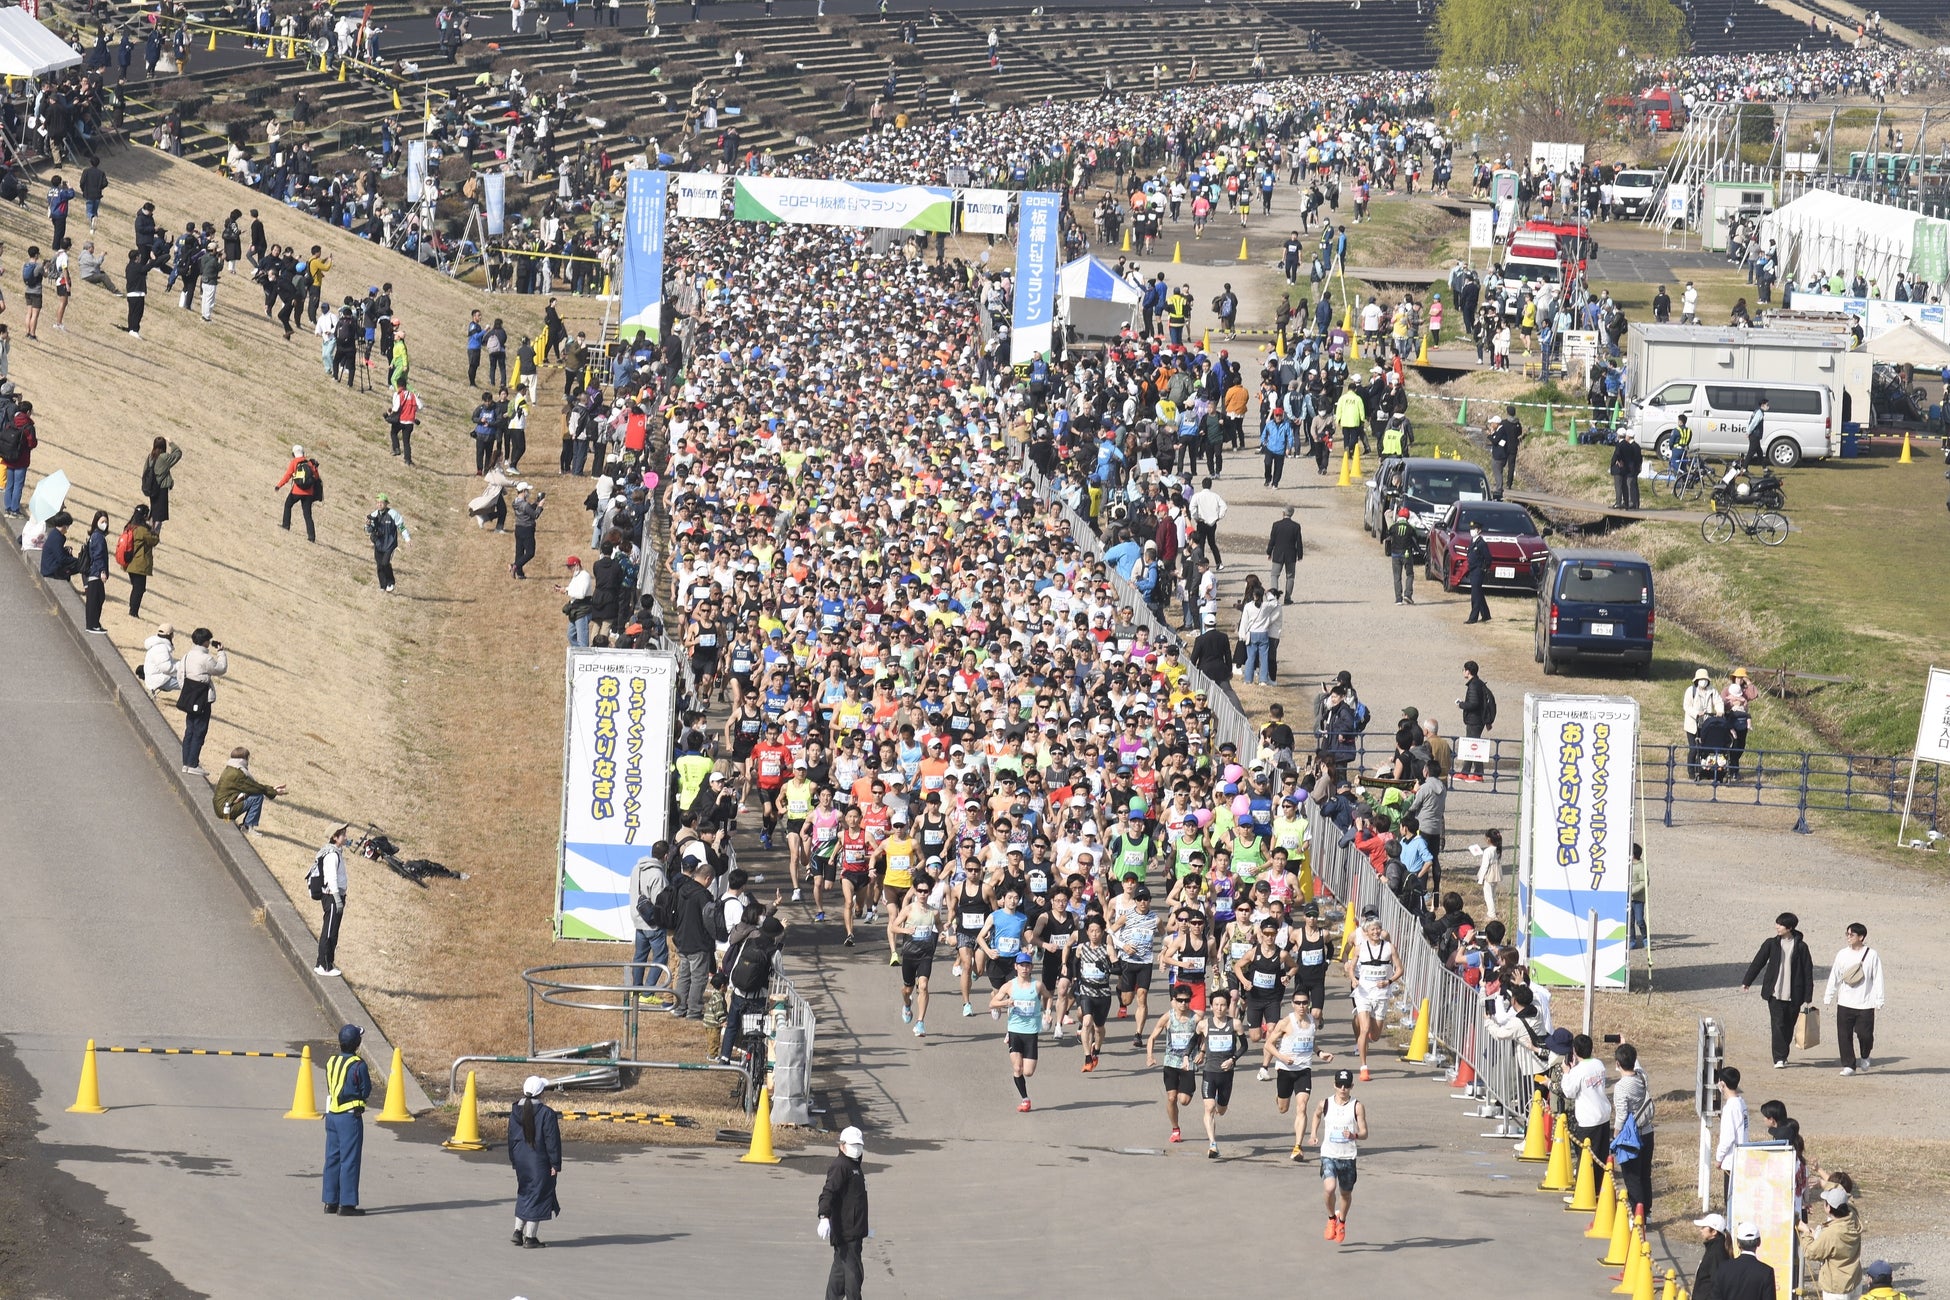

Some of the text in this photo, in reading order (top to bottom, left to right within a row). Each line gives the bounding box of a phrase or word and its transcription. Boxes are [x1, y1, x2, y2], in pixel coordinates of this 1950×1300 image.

[1026, 196, 1055, 206] 2024
[592, 675, 620, 820] おかえりなさい
[1556, 722, 1584, 866] おかえりなさい
